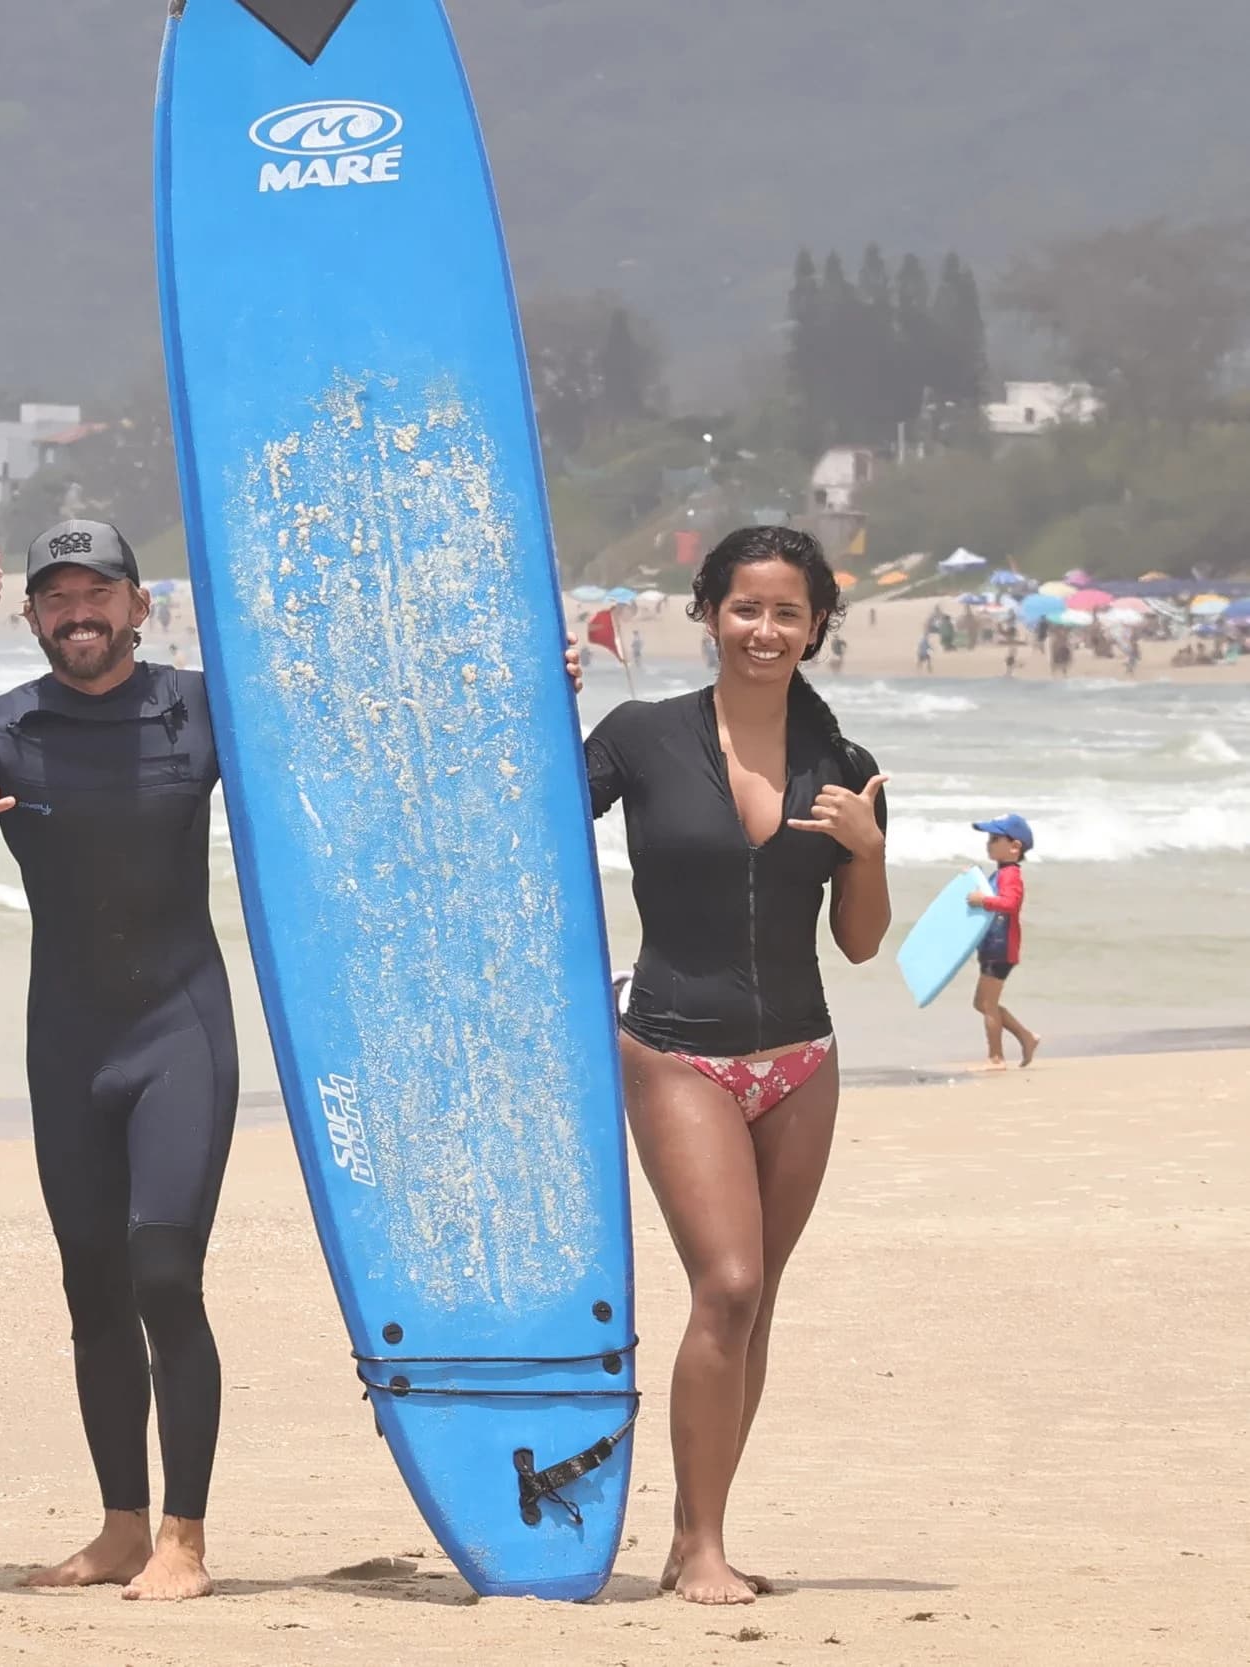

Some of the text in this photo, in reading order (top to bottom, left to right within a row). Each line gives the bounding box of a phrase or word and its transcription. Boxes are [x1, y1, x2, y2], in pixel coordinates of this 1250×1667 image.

[258, 144, 403, 193] MARÉ
[49, 531, 92, 549] GOOD
[50, 542, 92, 559] VIBES
[316, 1077, 351, 1168] SOFT
[328, 1072, 377, 1187] board
